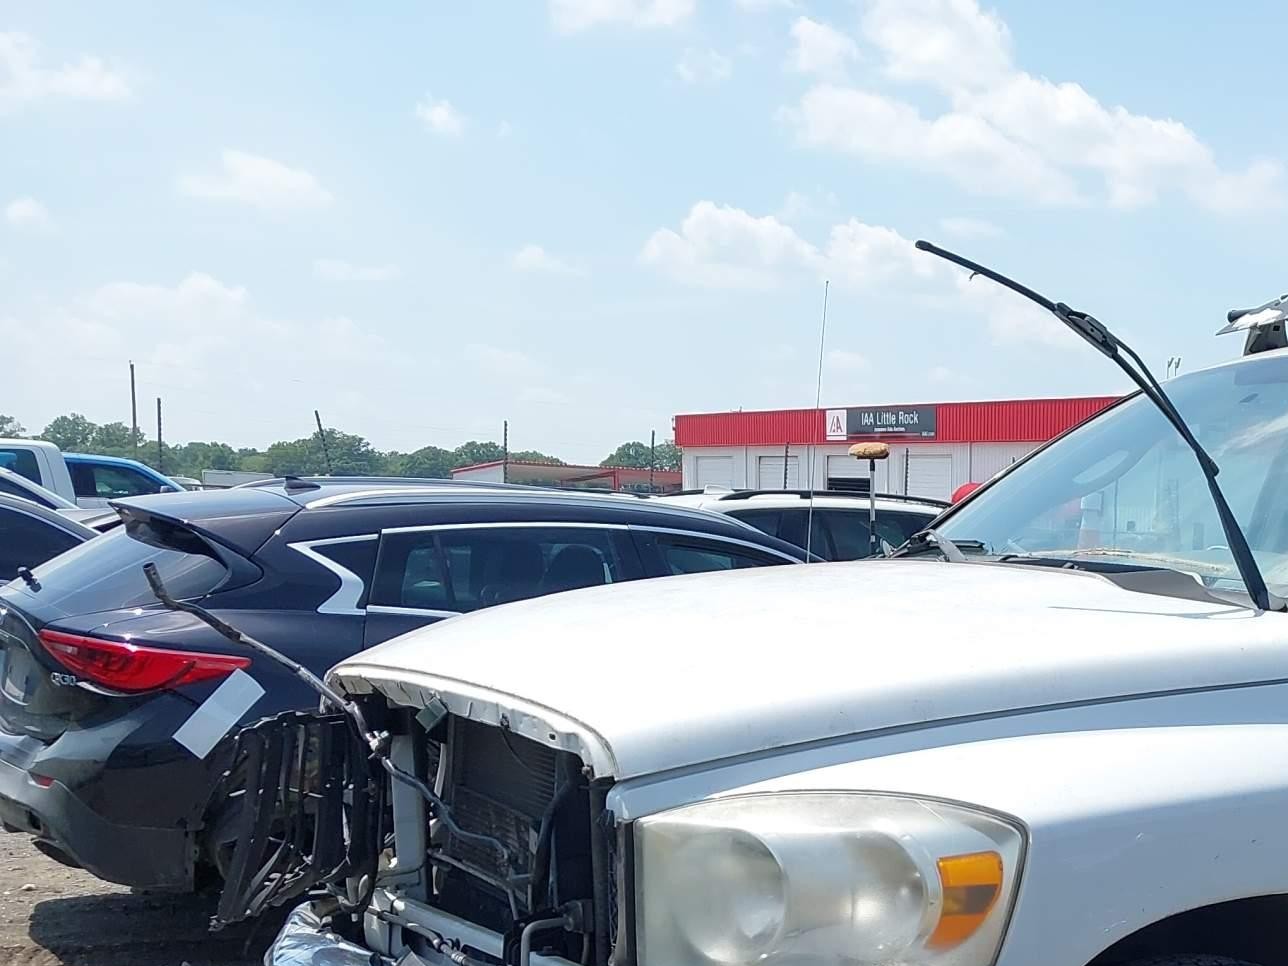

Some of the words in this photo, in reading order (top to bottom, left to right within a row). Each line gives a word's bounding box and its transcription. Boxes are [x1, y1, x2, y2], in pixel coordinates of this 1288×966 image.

[861, 411, 875, 426] IAA
[876, 411, 896, 425] Little
[898, 410, 919, 425] Rock
